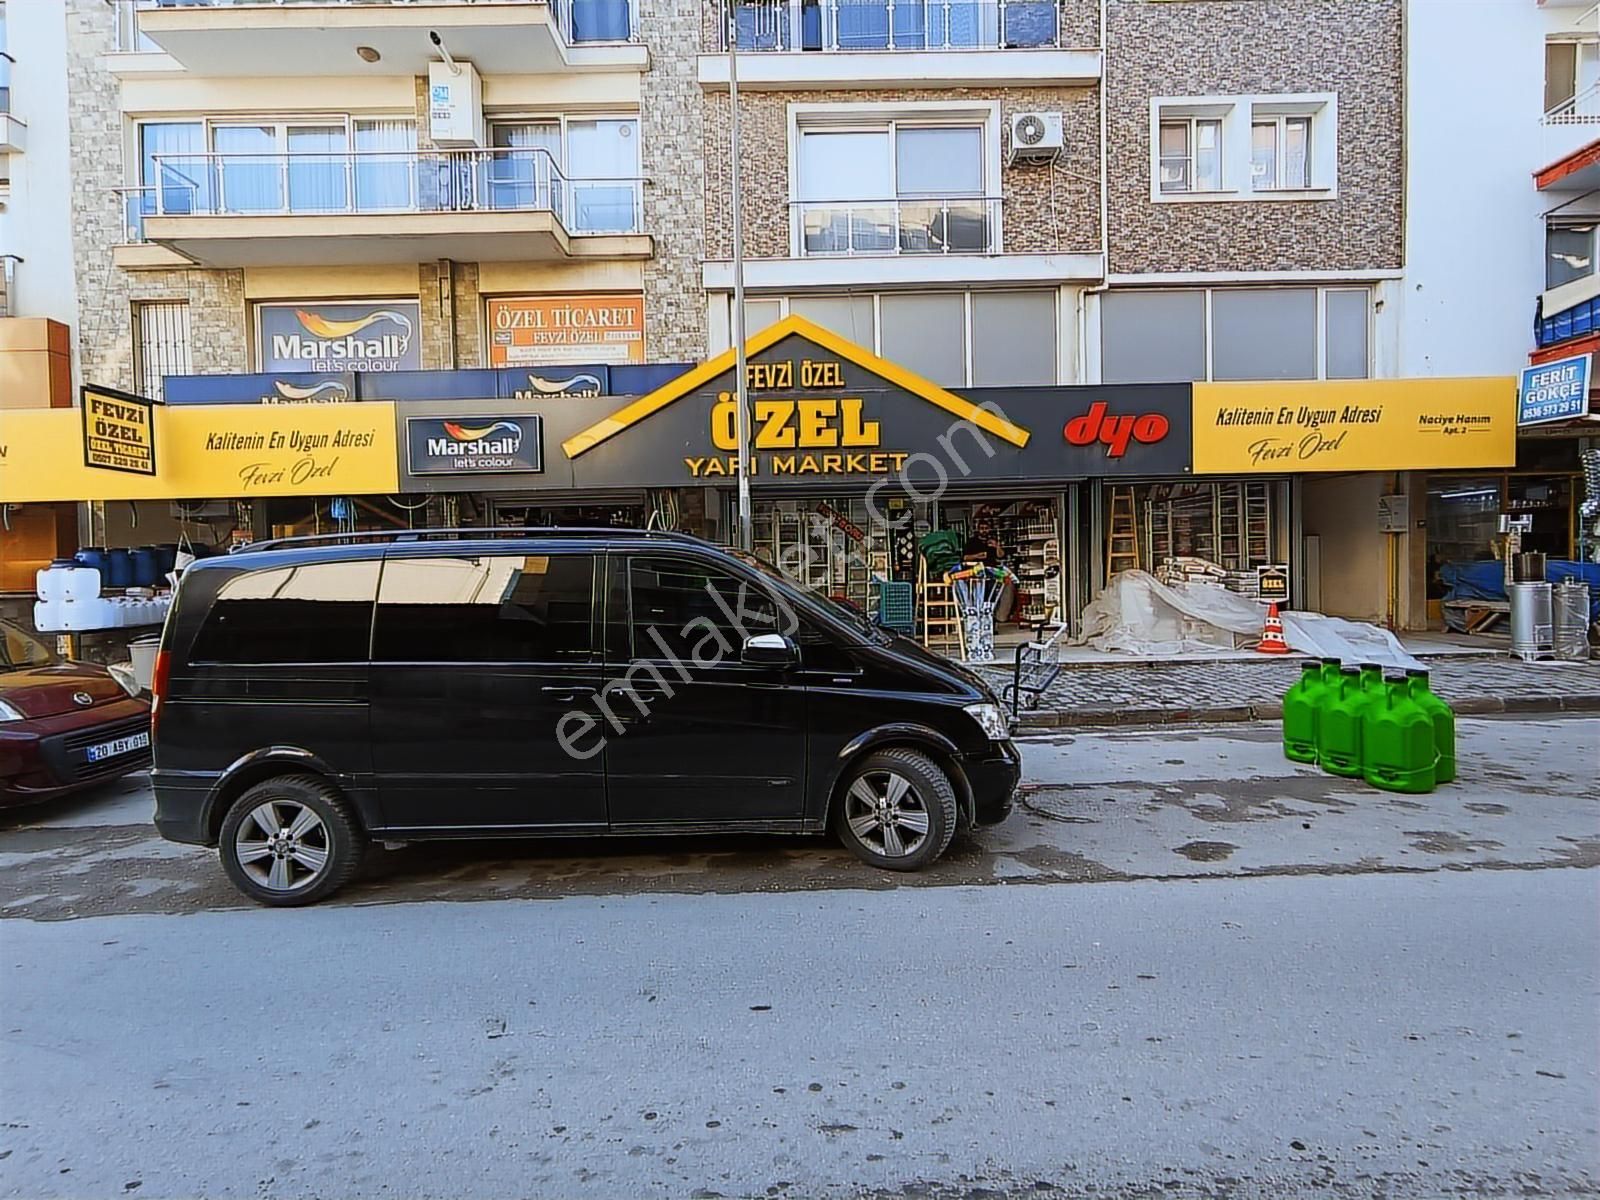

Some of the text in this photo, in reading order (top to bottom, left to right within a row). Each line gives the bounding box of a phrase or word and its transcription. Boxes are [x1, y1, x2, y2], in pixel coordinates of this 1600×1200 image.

[496, 304, 636, 329] ÖZEL TİCARET
[273, 335, 399, 359] Marshall
[312, 359, 399, 372] let's colour
[745, 360, 844, 389] FEVZİ ÖZEL
[1531, 366, 1577, 388] FERİT
[91, 399, 144, 424] FEVZİ
[1216, 404, 1384, 428] Kalitenin En Uygun Adresi
[1571, 400, 1581, 411] 51
[95, 417, 142, 443] ÖZEL
[711, 392, 880, 450] ÖZEL
[1064, 402, 1169, 457] dyo
[1419, 415, 1454, 425] Naciye
[205, 429, 376, 452] Kalitenin En Uygun Adresi
[427, 438, 514, 456] Marshall
[478, 457, 513, 468] colour
[772, 453, 908, 475] MARKET
